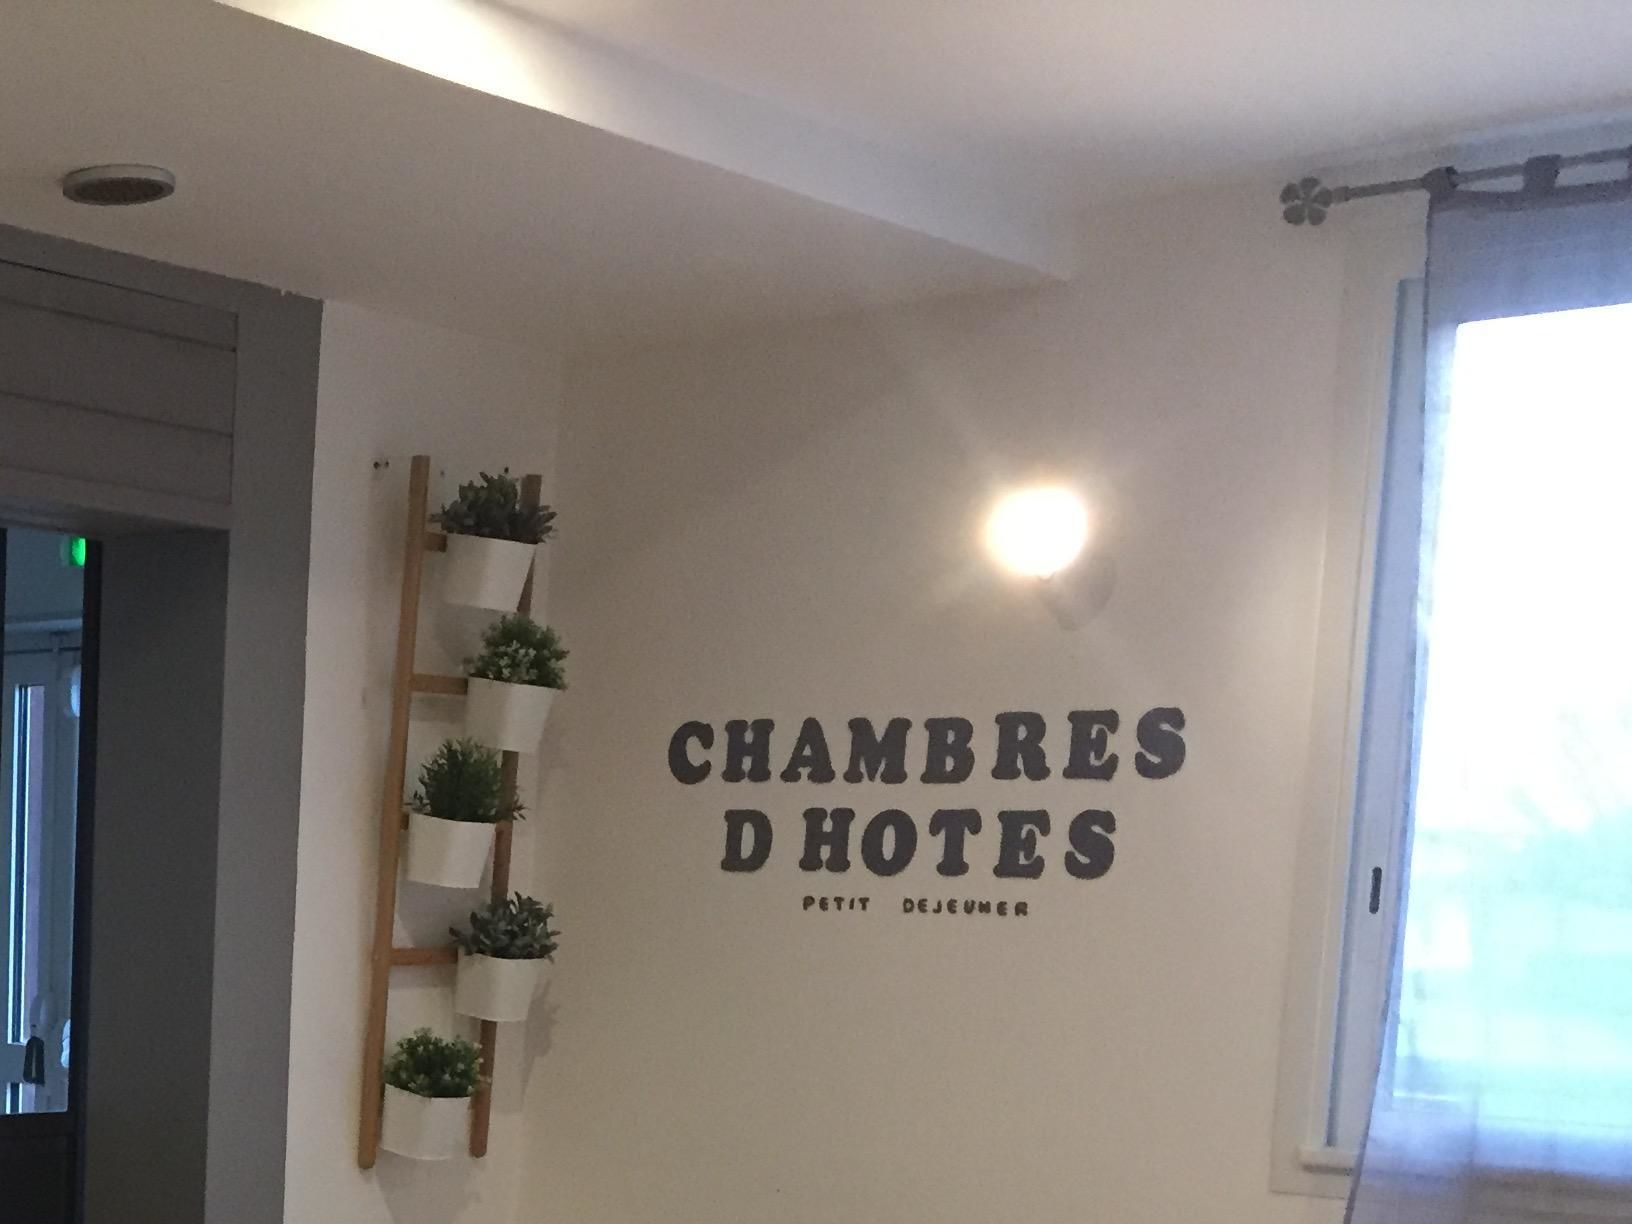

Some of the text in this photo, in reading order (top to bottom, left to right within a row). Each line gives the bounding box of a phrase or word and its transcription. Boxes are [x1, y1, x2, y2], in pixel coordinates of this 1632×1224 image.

[668, 706, 1186, 785] CHAMBRES
[720, 807, 1117, 880] D HOTES
[802, 895, 1029, 917] PETIT DEJEUNER
